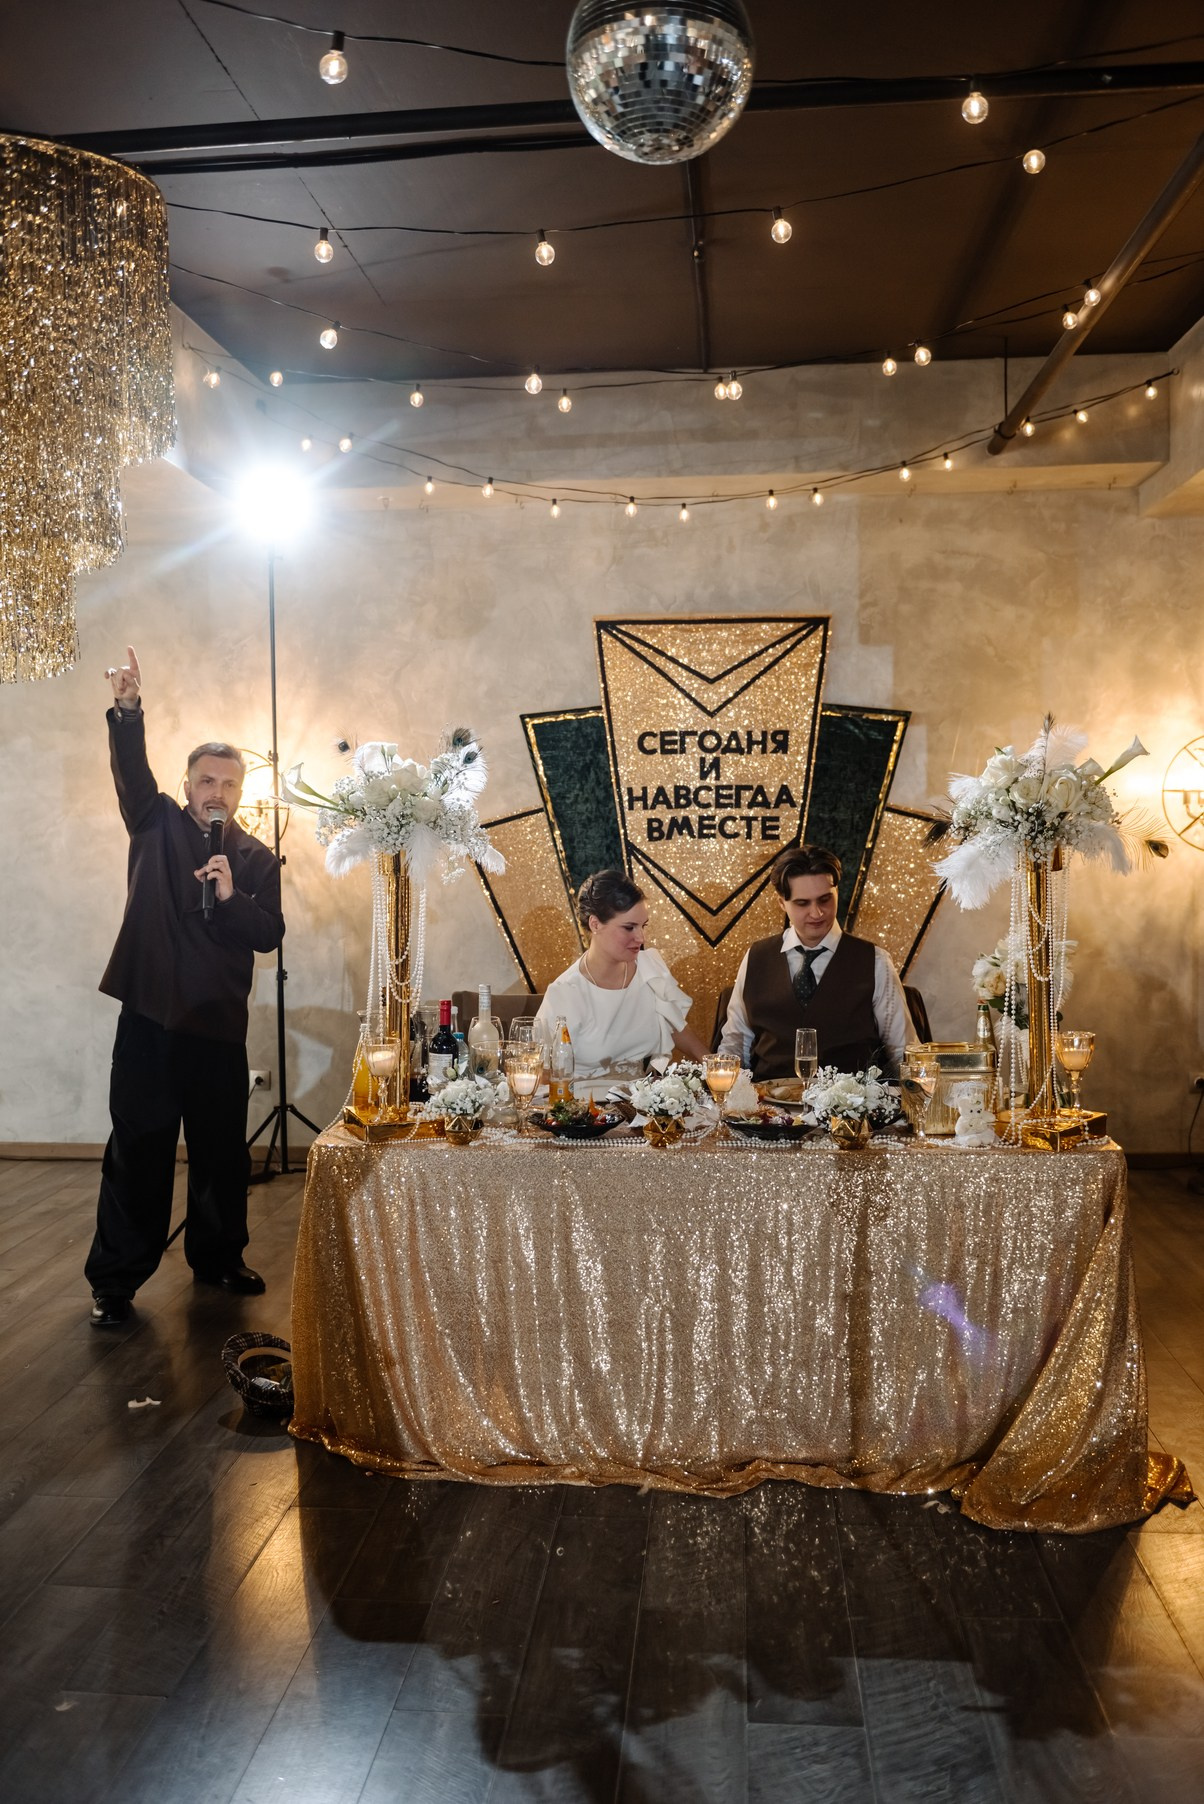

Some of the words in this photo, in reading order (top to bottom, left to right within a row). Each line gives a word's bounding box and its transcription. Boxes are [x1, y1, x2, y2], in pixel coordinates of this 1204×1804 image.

[638, 730, 790, 755] СЕГОДНЯ
[700, 757, 720, 780] И
[627, 785, 797, 810] НАВСЕГДА
[647, 816, 780, 841] ВМЕСТЕ
